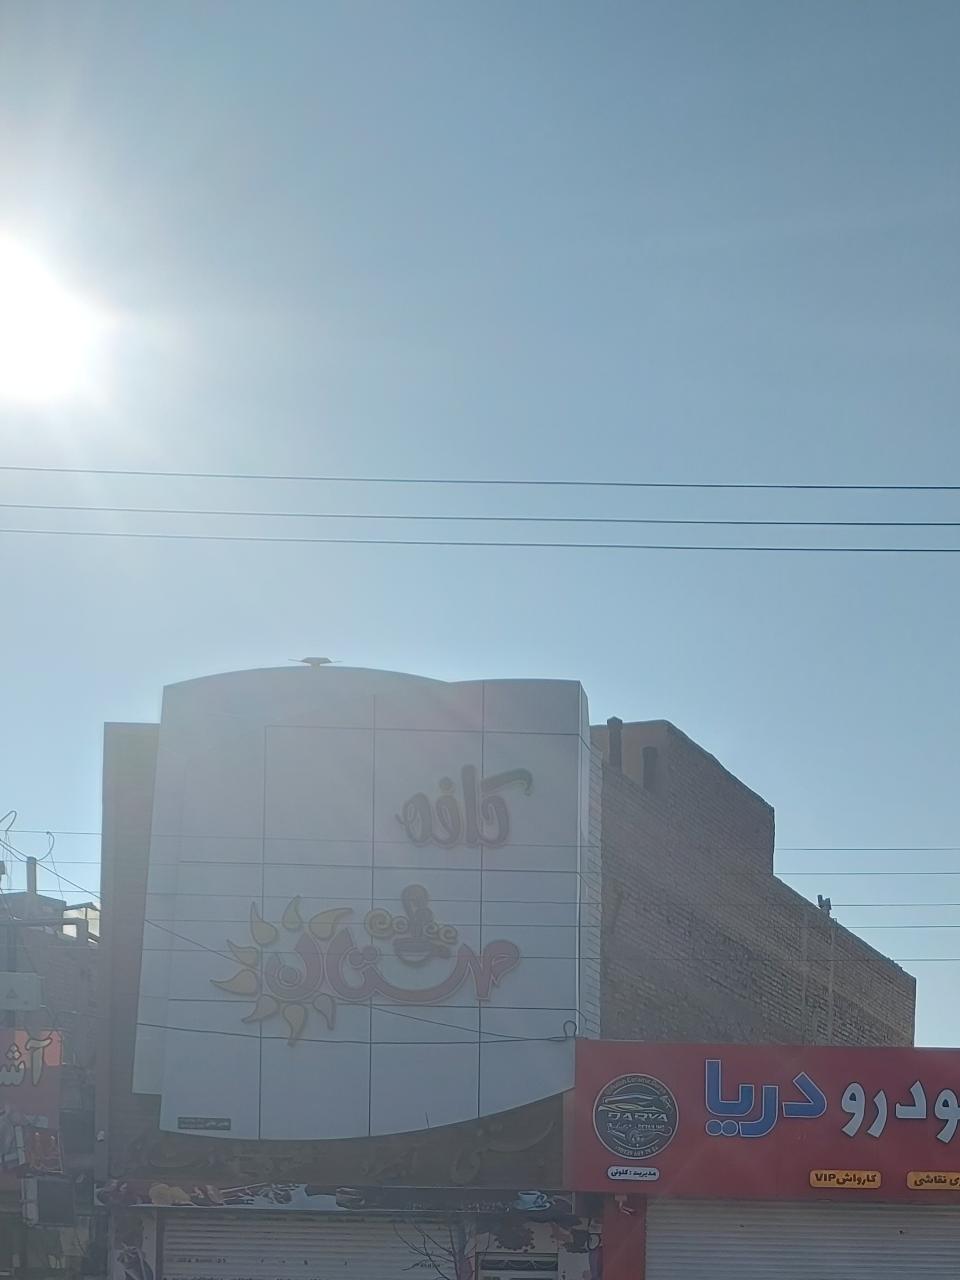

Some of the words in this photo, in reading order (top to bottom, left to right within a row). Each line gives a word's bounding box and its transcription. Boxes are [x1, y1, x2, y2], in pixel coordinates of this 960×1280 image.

[396, 764, 533, 848] کافه
[703, 1058, 828, 1138] دریا
[814, 1173, 836, 1182] VIP
[913, 1174, 947, 1187] نقاشی
